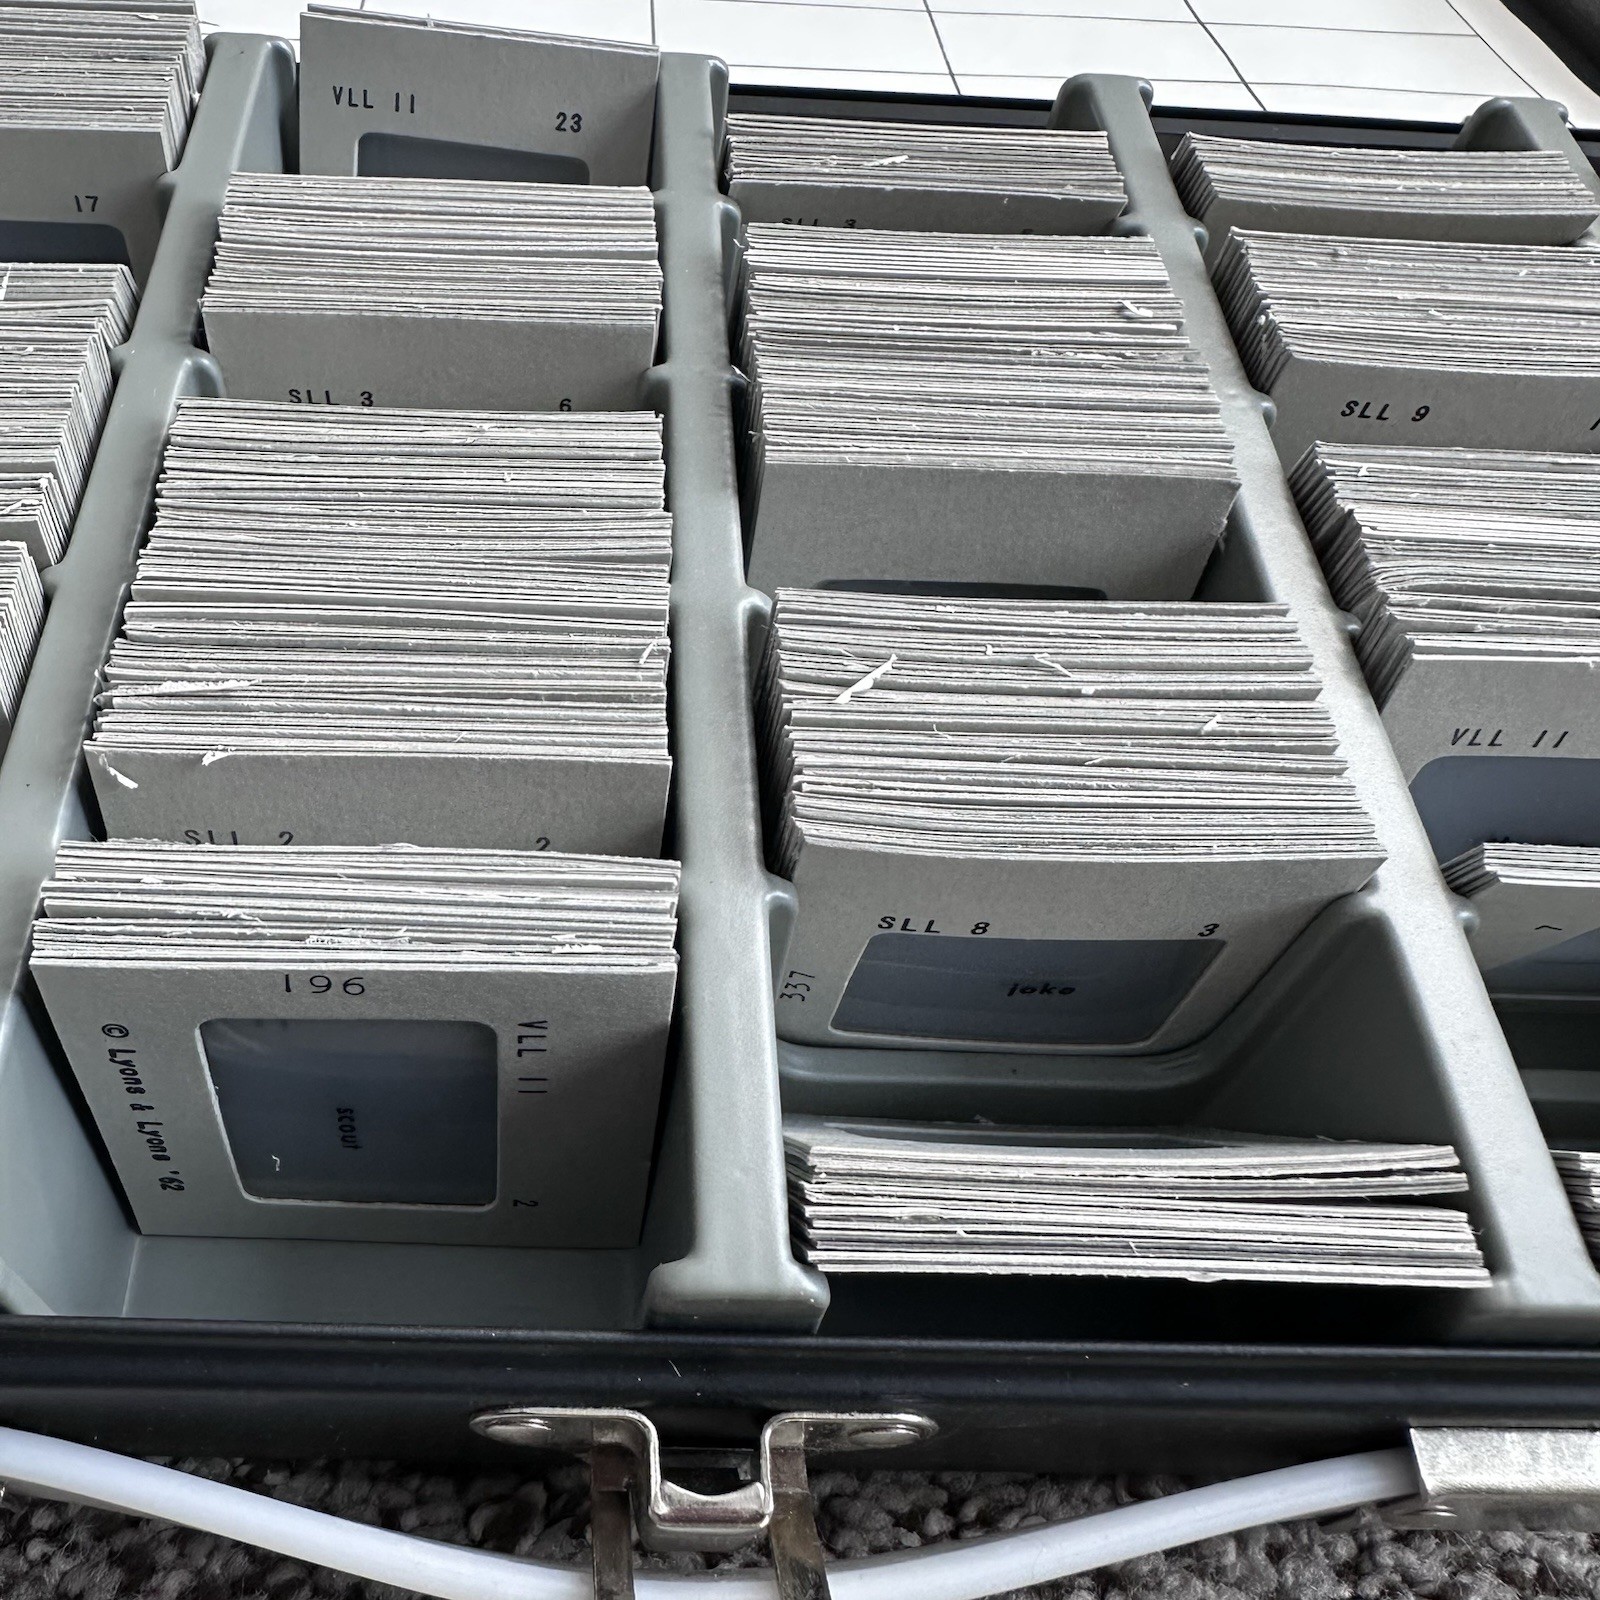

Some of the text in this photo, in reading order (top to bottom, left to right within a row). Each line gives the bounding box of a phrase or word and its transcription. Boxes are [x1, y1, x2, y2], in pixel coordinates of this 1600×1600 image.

[332, 85, 374, 109] VLL
[554, 111, 583, 133] 23
[74, 194, 98, 212] 17
[288, 388, 374, 407] SLL 3
[1340, 400, 1430, 422] SLL 9
[1451, 728, 1503, 747] VLL
[877, 915, 991, 935] SLL 8
[1197, 923, 1220, 937] 3
[284, 973, 366, 996] 196
[780, 970, 816, 1002] 337
[517, 1020, 549, 1058] VLL
[108, 1048, 146, 1095] Lyons
[136, 1121, 171, 1161] Lyons
[336, 1107, 363, 1149] scout
[512, 1199, 539, 1207] 2
